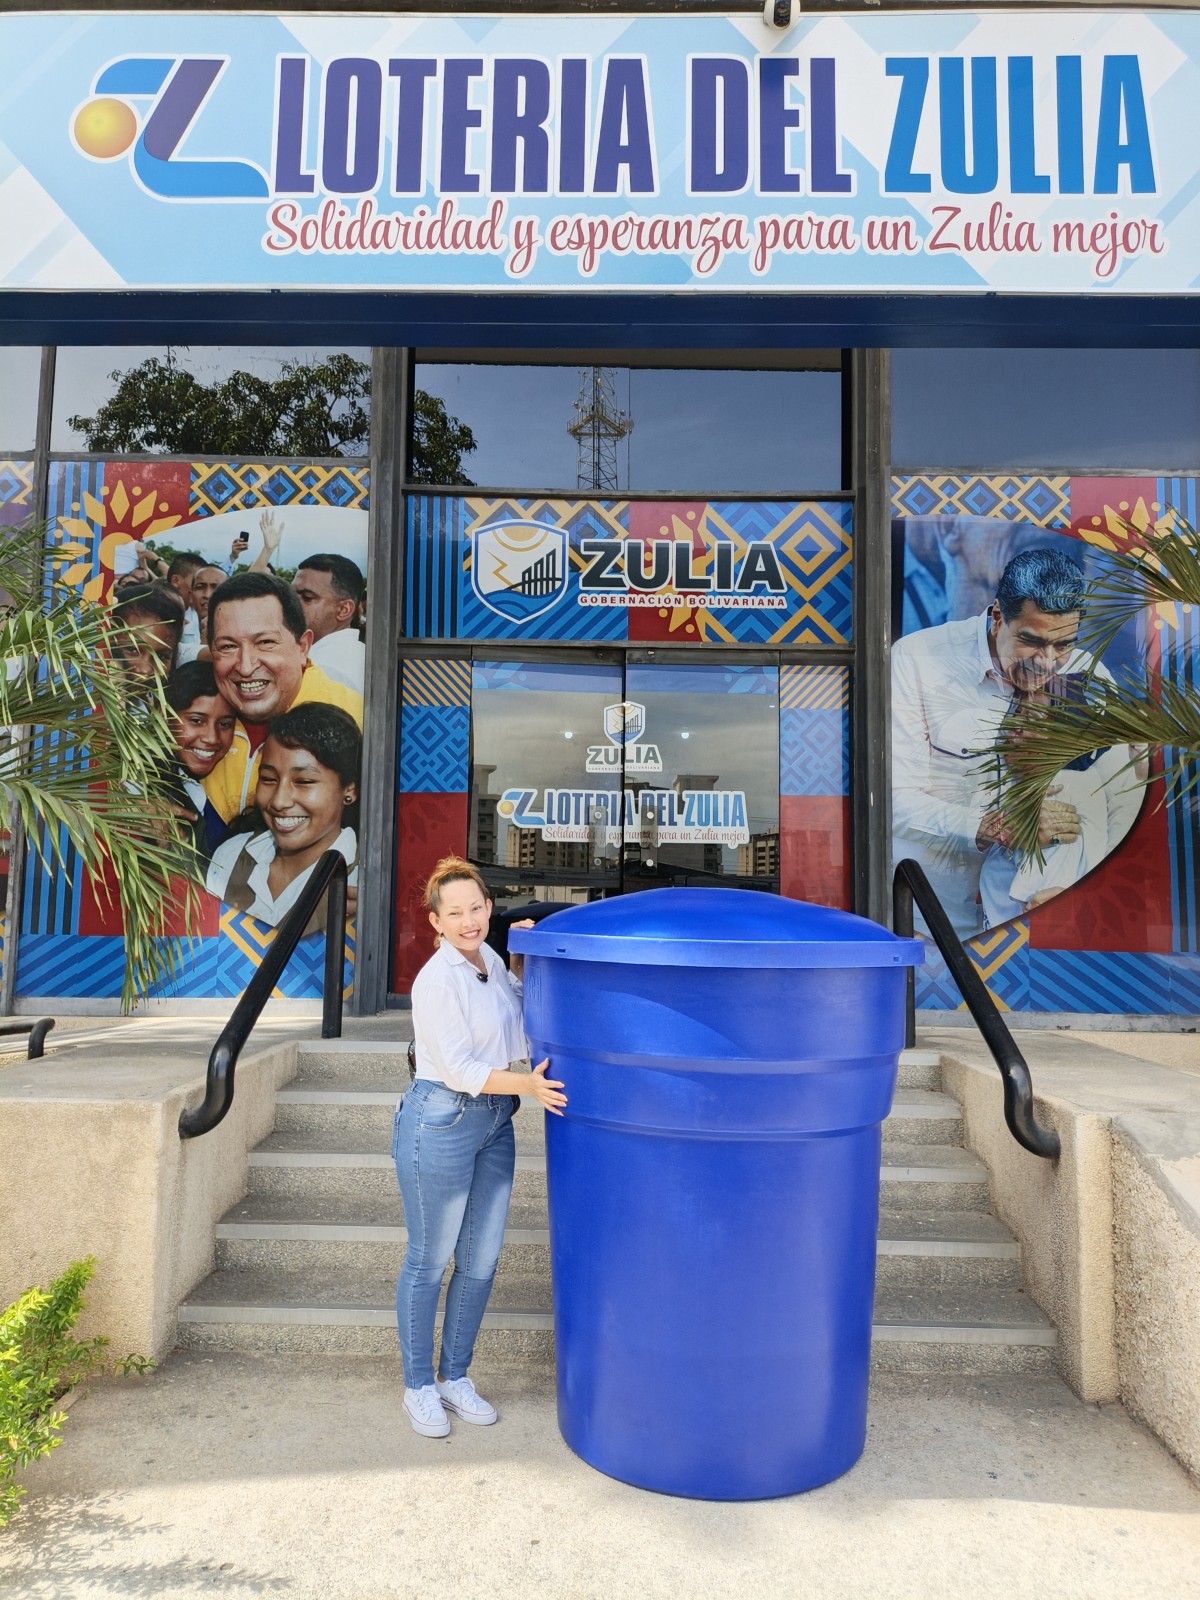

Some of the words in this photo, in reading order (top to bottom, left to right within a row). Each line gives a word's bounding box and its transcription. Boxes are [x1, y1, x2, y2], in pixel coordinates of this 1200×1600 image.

[274, 57, 654, 194] LOTERIA
[690, 57, 852, 194] DEL
[884, 54, 1157, 195] ZULIA
[266, 199, 505, 251] Solidaridad
[509, 222, 539, 274] y
[550, 214, 750, 274] esperanza
[755, 217, 854, 272] para
[867, 219, 916, 252] un
[928, 201, 1041, 253] Zulia
[1053, 212, 1164, 277] mejor
[580, 541, 785, 591] ZULIA
[579, 594, 682, 606] GOBERNACIÓN
[689, 598, 786, 607] BOLIVARIANA
[588, 746, 660, 765] ZULIA
[546, 791, 634, 826] LOTERIA
[684, 793, 746, 827] ZULIA
[680, 831, 692, 840] un
[693, 828, 719, 841] Zulia
[721, 830, 746, 846] mejor
